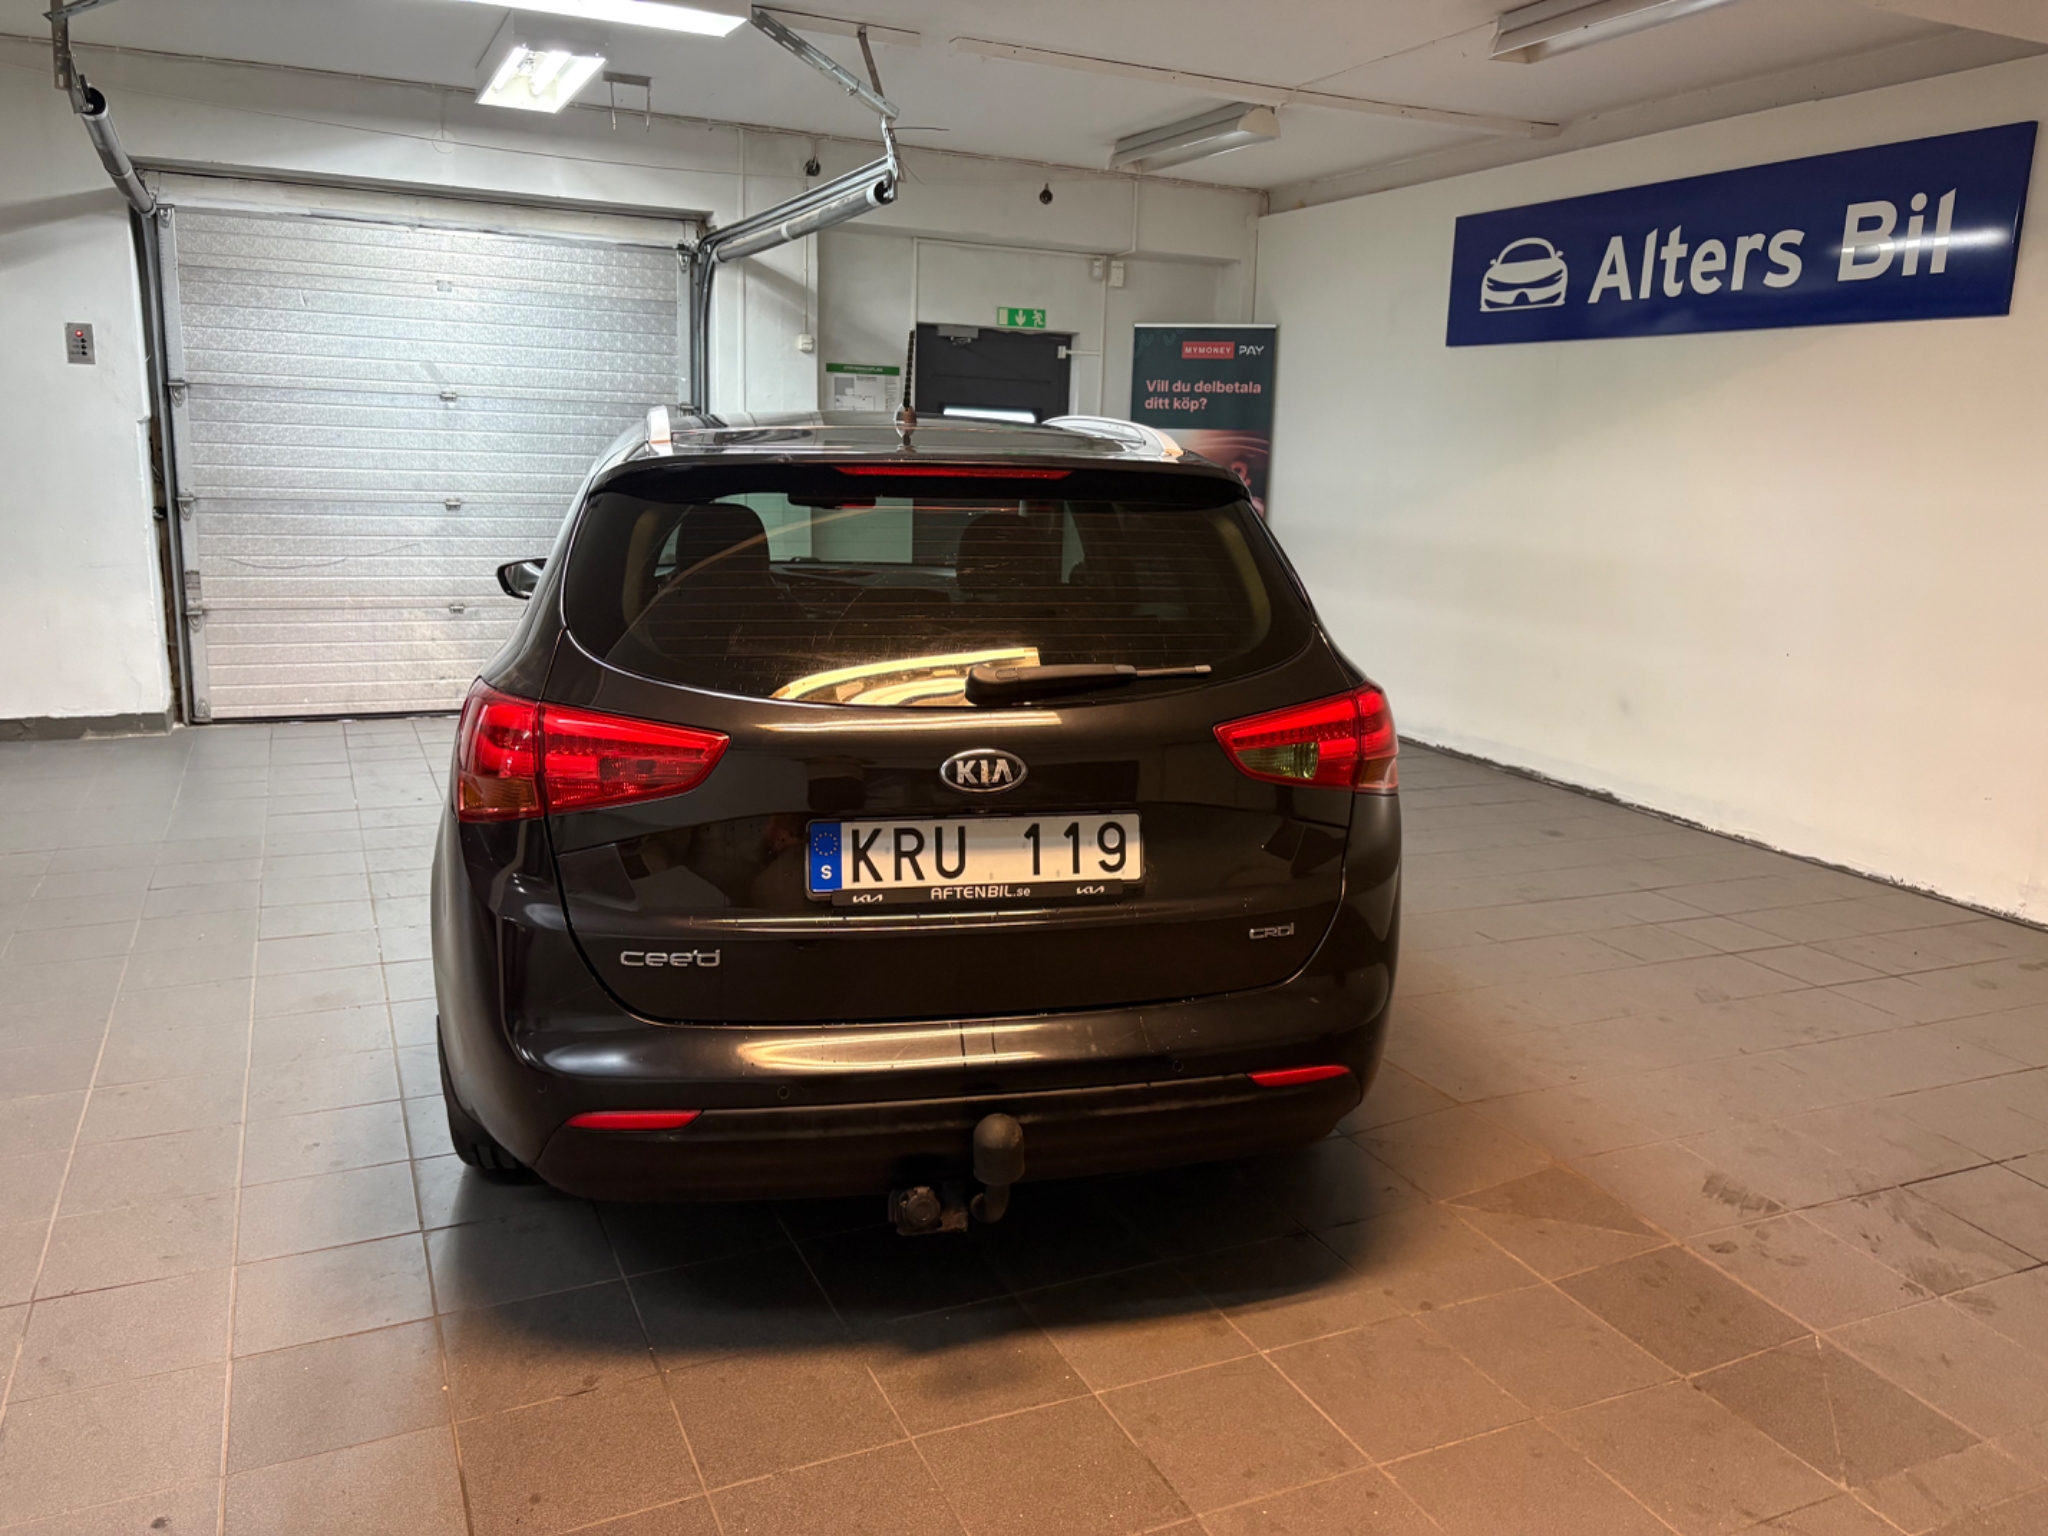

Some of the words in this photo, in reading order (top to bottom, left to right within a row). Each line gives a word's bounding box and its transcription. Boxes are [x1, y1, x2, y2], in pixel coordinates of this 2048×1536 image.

[1587, 224, 1805, 304] Alters
[1836, 187, 1957, 282] Bil
[1184, 346, 1232, 354] MYMONEY
[1239, 345, 1264, 355] PAY
[1146, 379, 1169, 393] Vill
[1172, 380, 1191, 393] du
[1194, 380, 1261, 394] delbetala
[1144, 397, 1170, 410] ditt
[1172, 397, 1208, 412] köp?
[955, 758, 1014, 785] KIA
[851, 825, 966, 883] KRU
[1023, 821, 1127, 876] 119
[820, 864, 833, 880] S
[930, 884, 1031, 900] AFTENBIL.se
[620, 949, 721, 967] cee'd
